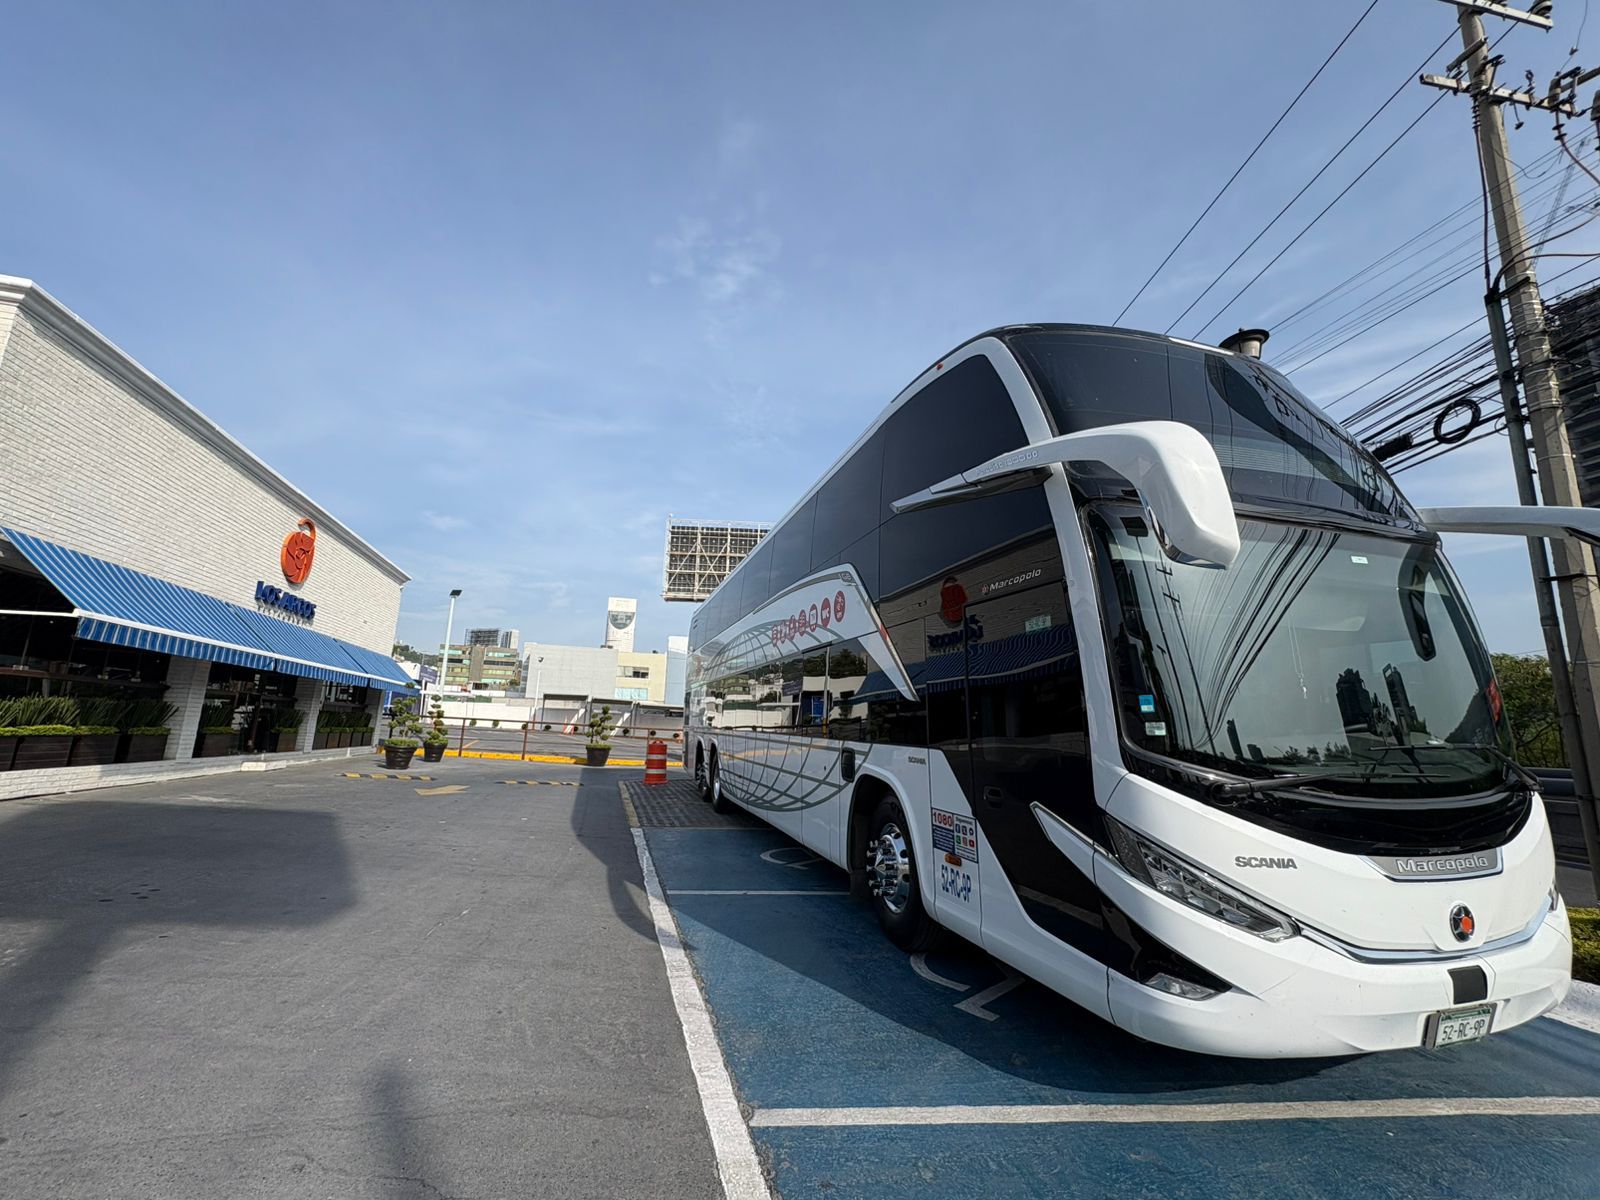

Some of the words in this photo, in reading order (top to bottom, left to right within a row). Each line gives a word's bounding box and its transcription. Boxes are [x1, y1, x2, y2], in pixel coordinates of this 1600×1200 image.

[989, 568, 1042, 591] Marcopolo
[933, 811, 953, 827] 1080
[1234, 855, 1297, 870] SCANIA
[1396, 854, 1488, 874] Marcopolo
[941, 864, 972, 903] 52-RC-9P
[1442, 1019, 1486, 1042] 52-RC-9P
